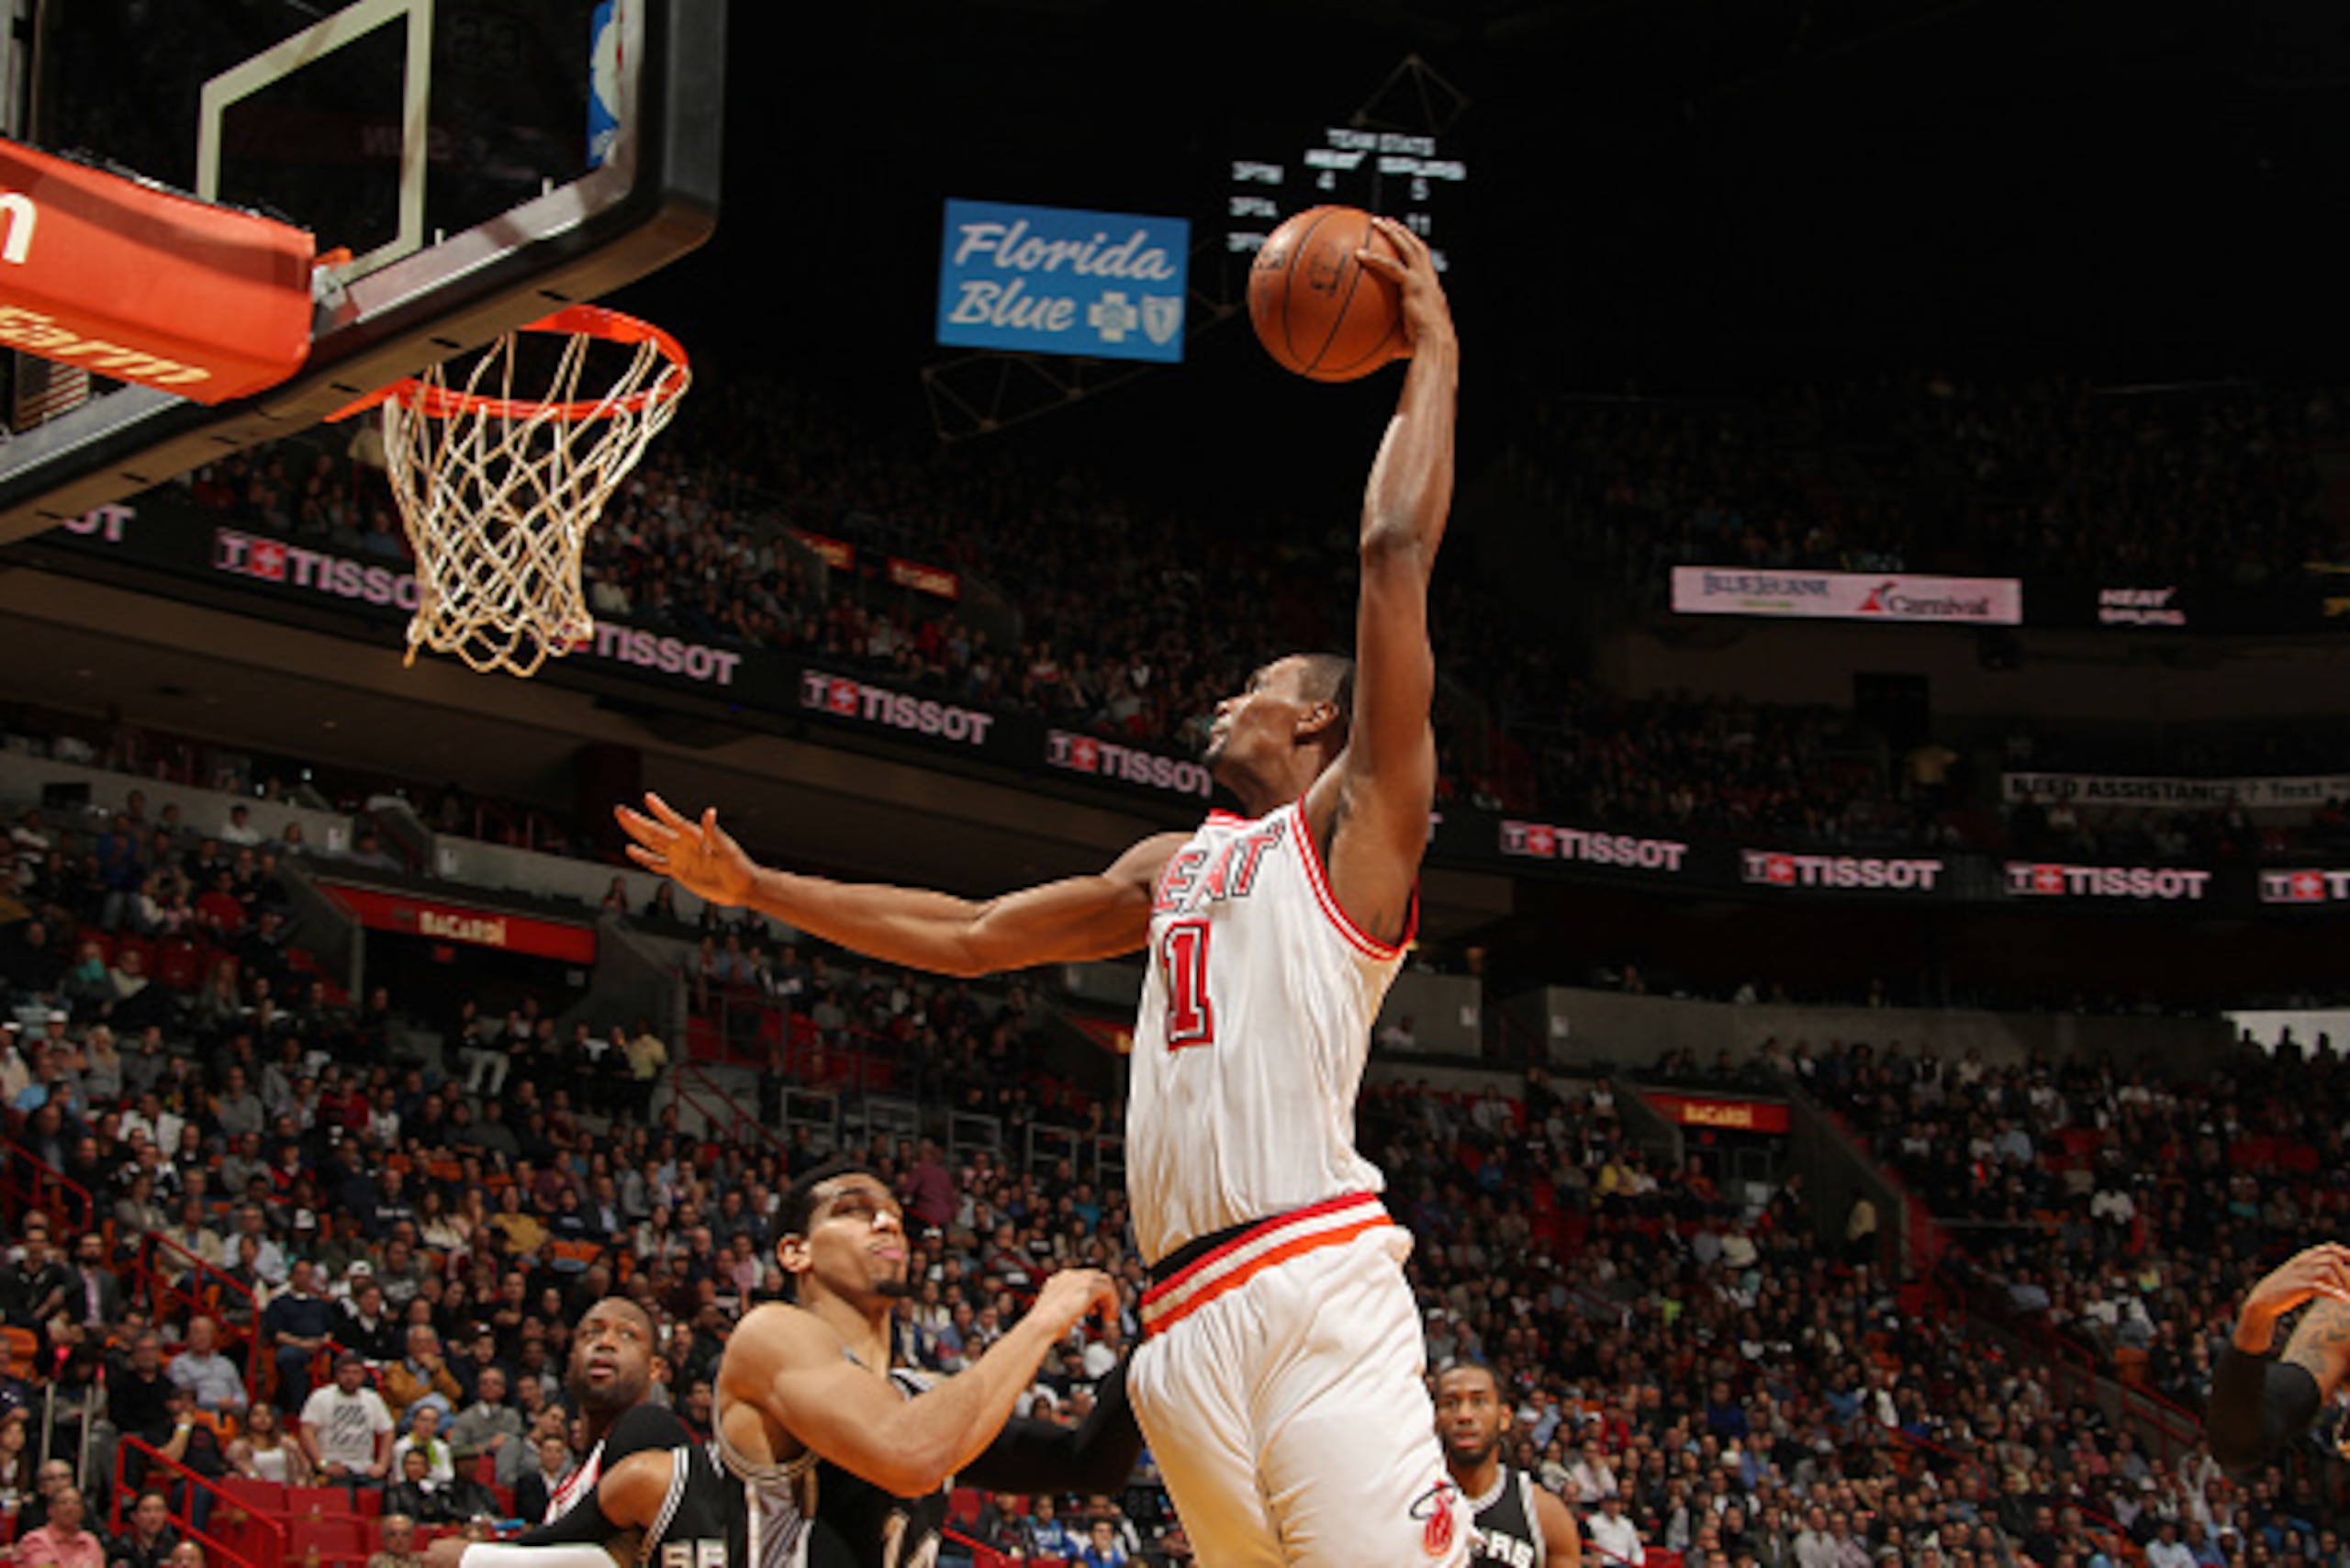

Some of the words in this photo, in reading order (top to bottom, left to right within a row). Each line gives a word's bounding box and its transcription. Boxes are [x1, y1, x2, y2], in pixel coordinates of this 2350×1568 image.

[954, 219, 1176, 279] Florida
[948, 277, 1076, 331] Blue
[285, 547, 420, 610] TISSO
[1887, 595, 1989, 616] Carnival
[596, 621, 742, 686] TISSOT
[857, 684, 994, 745] TISSOT
[1154, 819, 1284, 914] EAT
[1555, 826, 1689, 871] TISSOT
[1795, 854, 1944, 891] TISSOT
[2063, 865, 2213, 900] TISSOT
[1163, 920, 1214, 1050] 1
